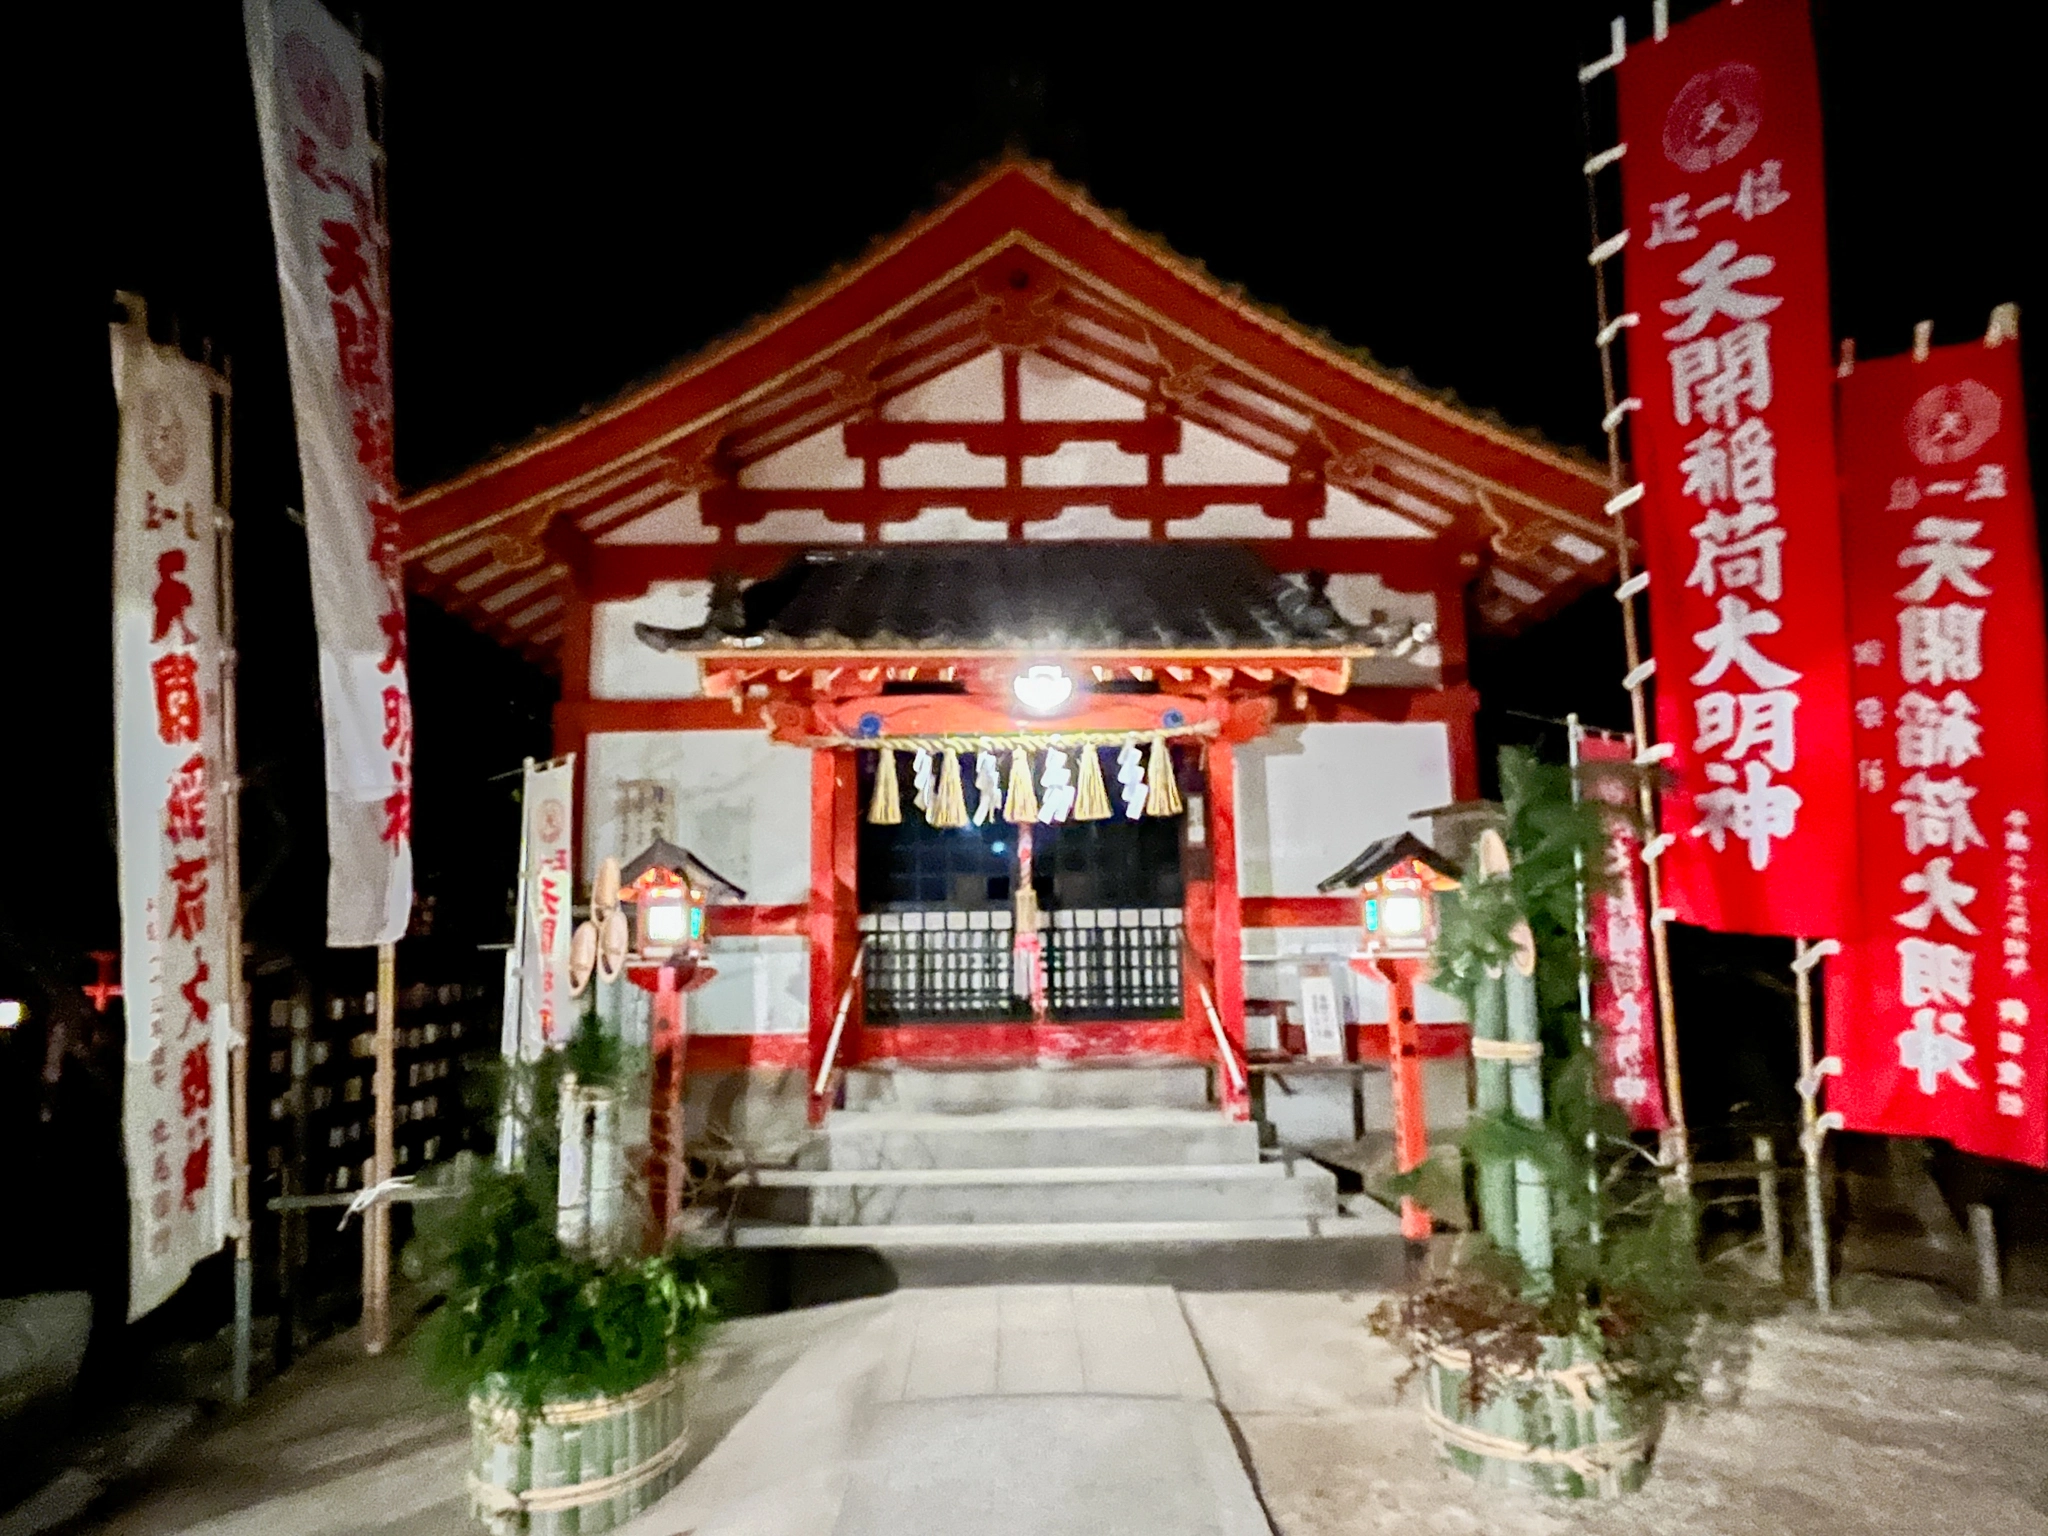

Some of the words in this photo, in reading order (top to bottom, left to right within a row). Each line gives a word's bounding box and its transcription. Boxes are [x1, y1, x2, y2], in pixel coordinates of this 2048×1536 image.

[1643, 159, 1791, 250] 正一位
[1659, 239, 1803, 870] 天開稲荷大明神
